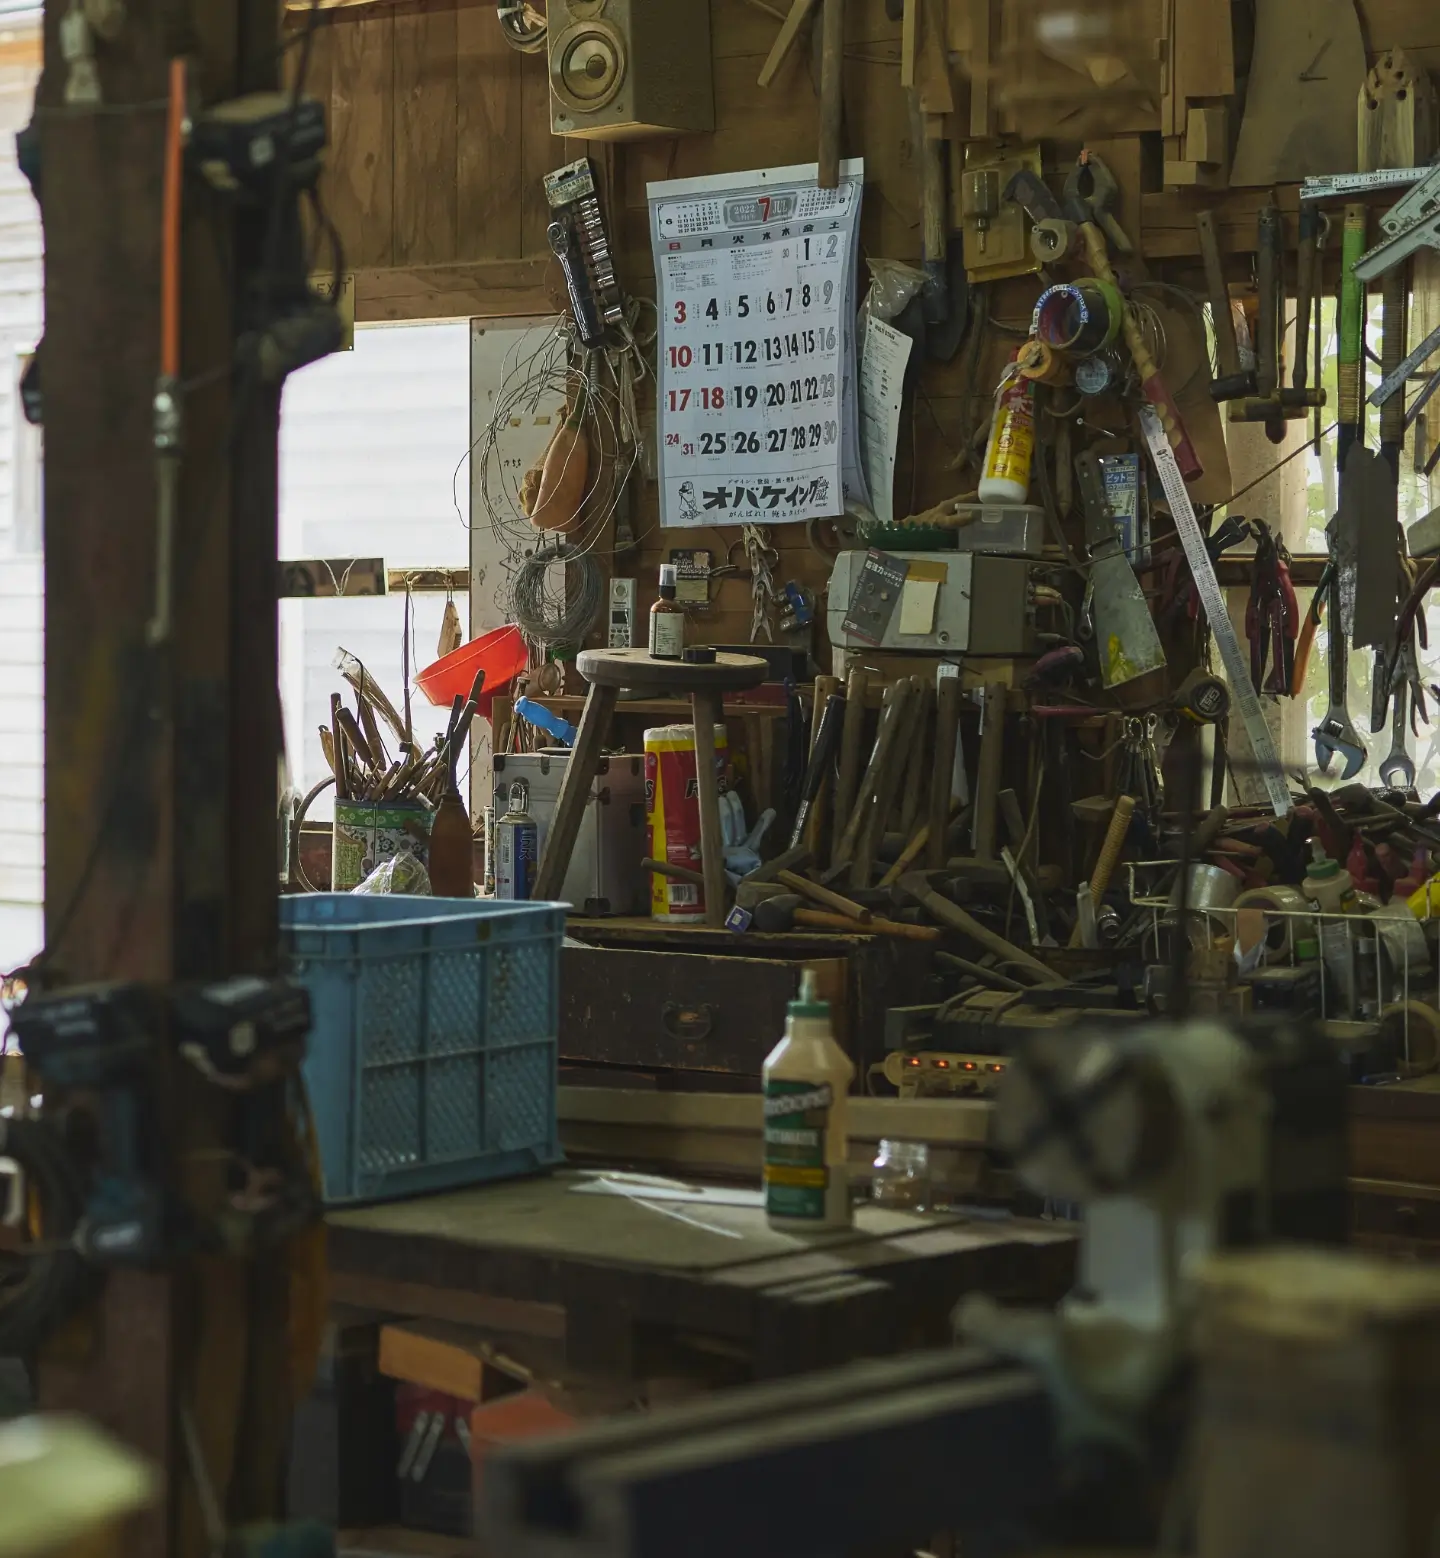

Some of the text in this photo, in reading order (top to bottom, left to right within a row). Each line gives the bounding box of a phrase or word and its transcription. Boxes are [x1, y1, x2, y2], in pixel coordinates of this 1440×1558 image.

[733, 205, 756, 214] 2022
[757, 197, 771, 222] 7
[669, 220, 840, 250] 日 月 火 水 木 金 土
[782, 234, 838, 260] 30 1 2
[316, 280, 350, 296] EXT
[673, 280, 834, 324] 3 4 5 6 7 8 9
[668, 346, 692, 368] 10
[702, 342, 724, 366] 11
[734, 340, 758, 363] 12
[764, 336, 782, 361] 13
[784, 333, 799, 358] 14
[802, 330, 815, 354] 15
[818, 327, 836, 351] 16
[668, 373, 835, 412] 17 18 19 20 21 22 23
[666, 420, 837, 454] 24 25 26 27 28 29 30
[682, 443, 694, 456] 31
[1106, 473, 1126, 484] ビット
